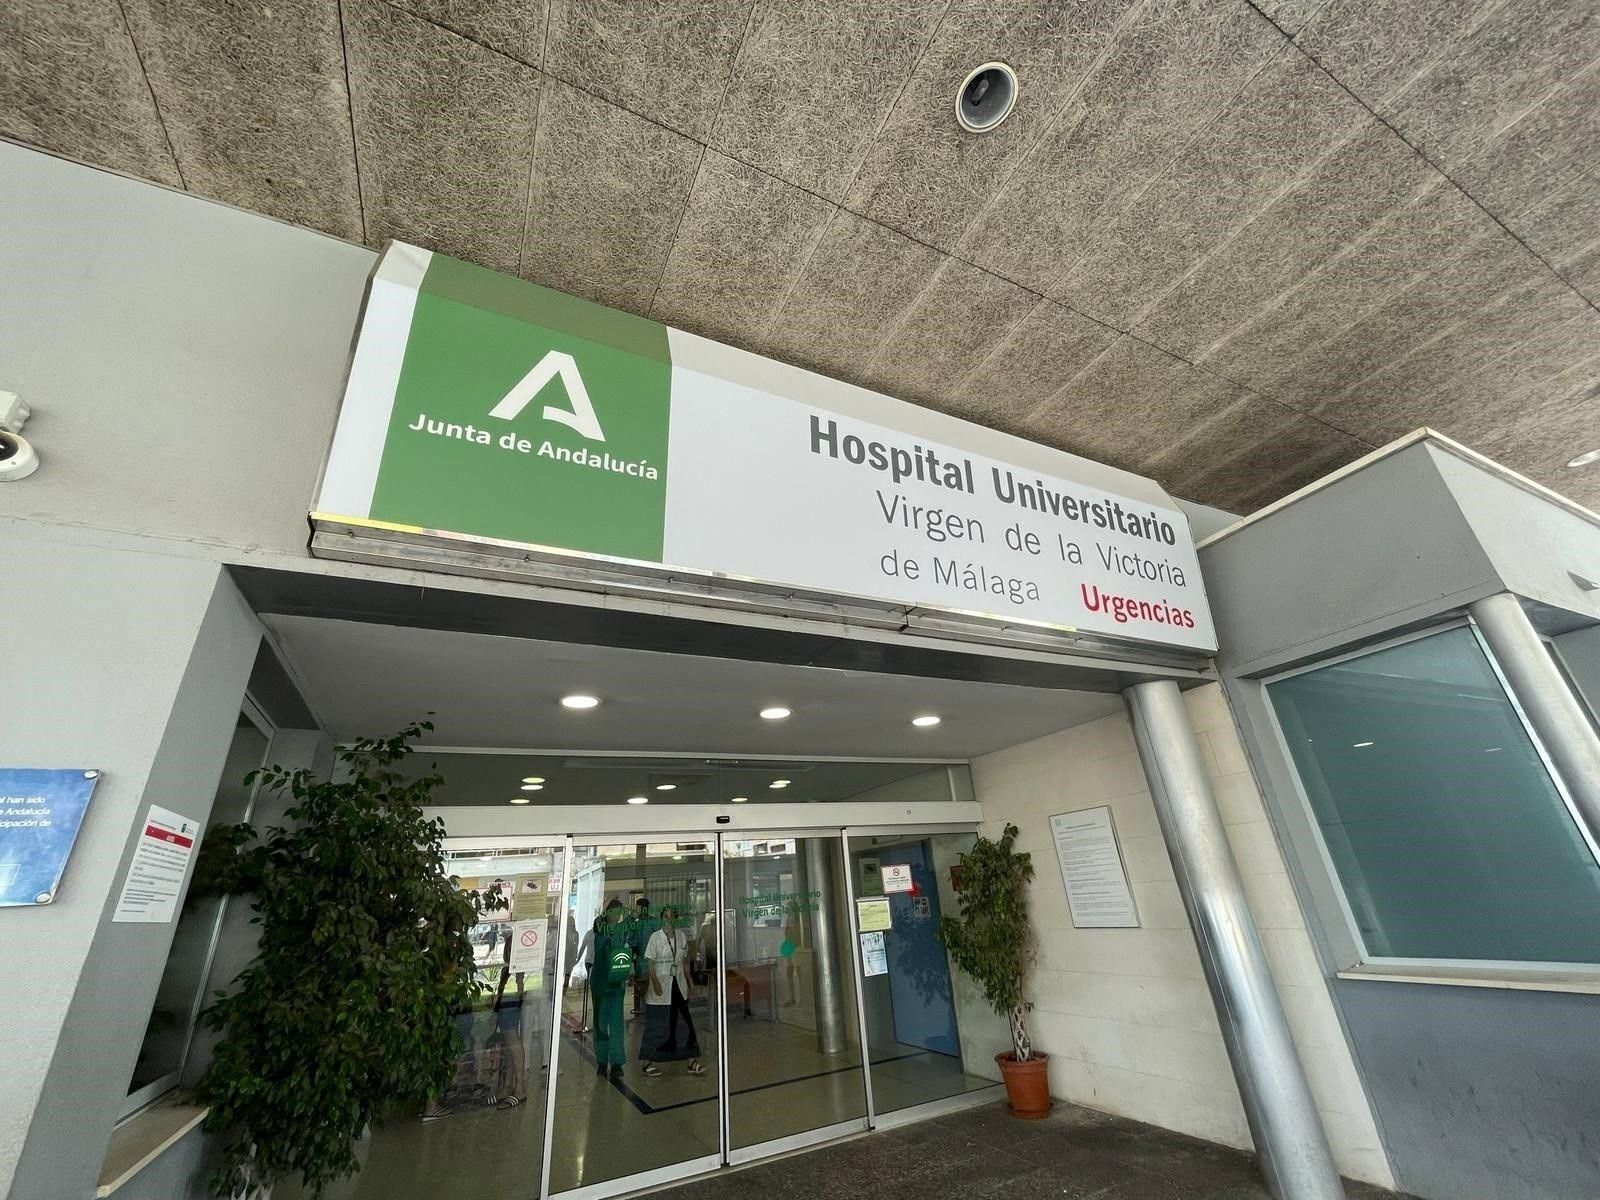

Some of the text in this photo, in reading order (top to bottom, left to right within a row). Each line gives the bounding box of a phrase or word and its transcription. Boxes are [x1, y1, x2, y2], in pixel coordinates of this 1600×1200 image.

[408, 413, 659, 480] Junta de Andalucía
[809, 414, 1176, 546] Hospital Universitario
[876, 489, 1187, 588] Virgen de la Victoria
[880, 549, 1040, 605] de Málaga
[1080, 582, 1195, 629] Urgencias
[5, 807, 51, 815] Andalucía
[26, 795, 46, 803] sido
[40, 819, 52, 827] de
[742, 907, 769, 919] Virgen
